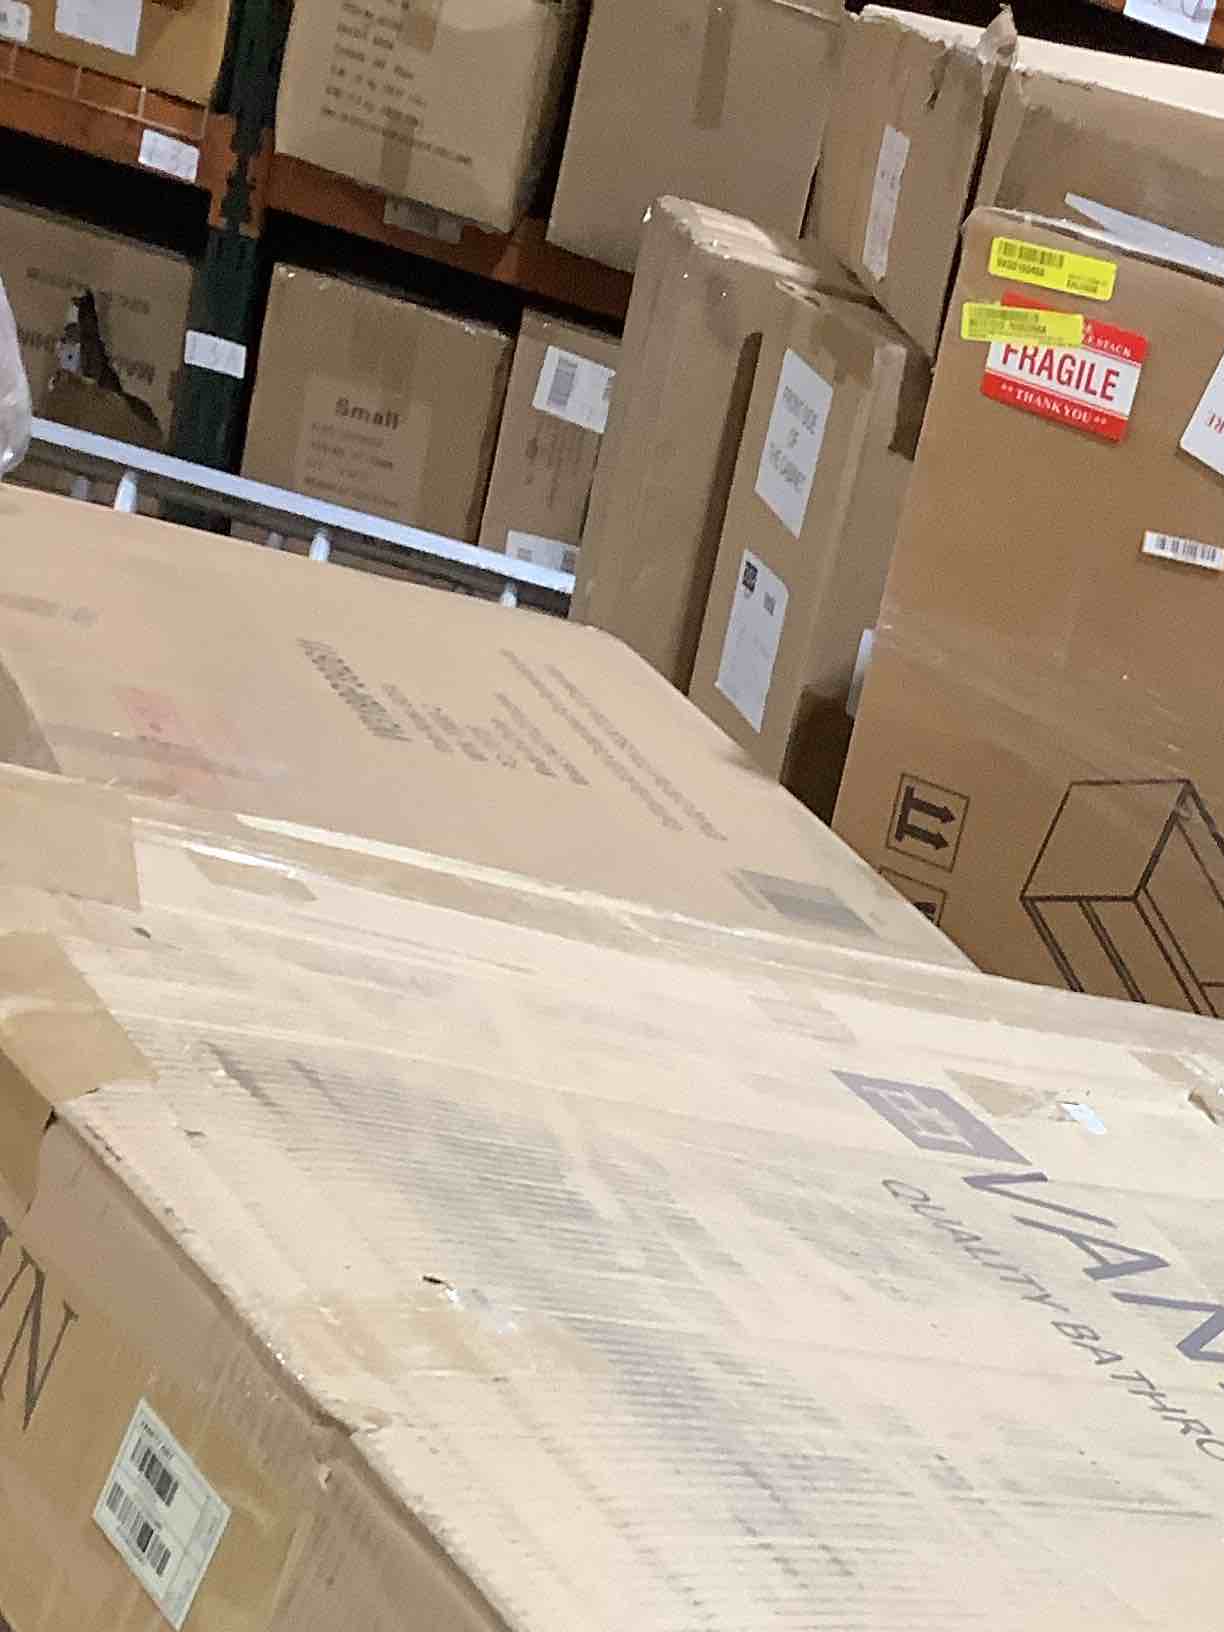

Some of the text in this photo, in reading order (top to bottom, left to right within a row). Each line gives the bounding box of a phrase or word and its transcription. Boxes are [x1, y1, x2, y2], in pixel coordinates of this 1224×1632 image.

[1001, 343, 1121, 403] FRAGILE
[335, 397, 400, 431] Small
[1015, 389, 1092, 424] THANK YOU
[881, 1178, 1070, 1313] QUALITY
